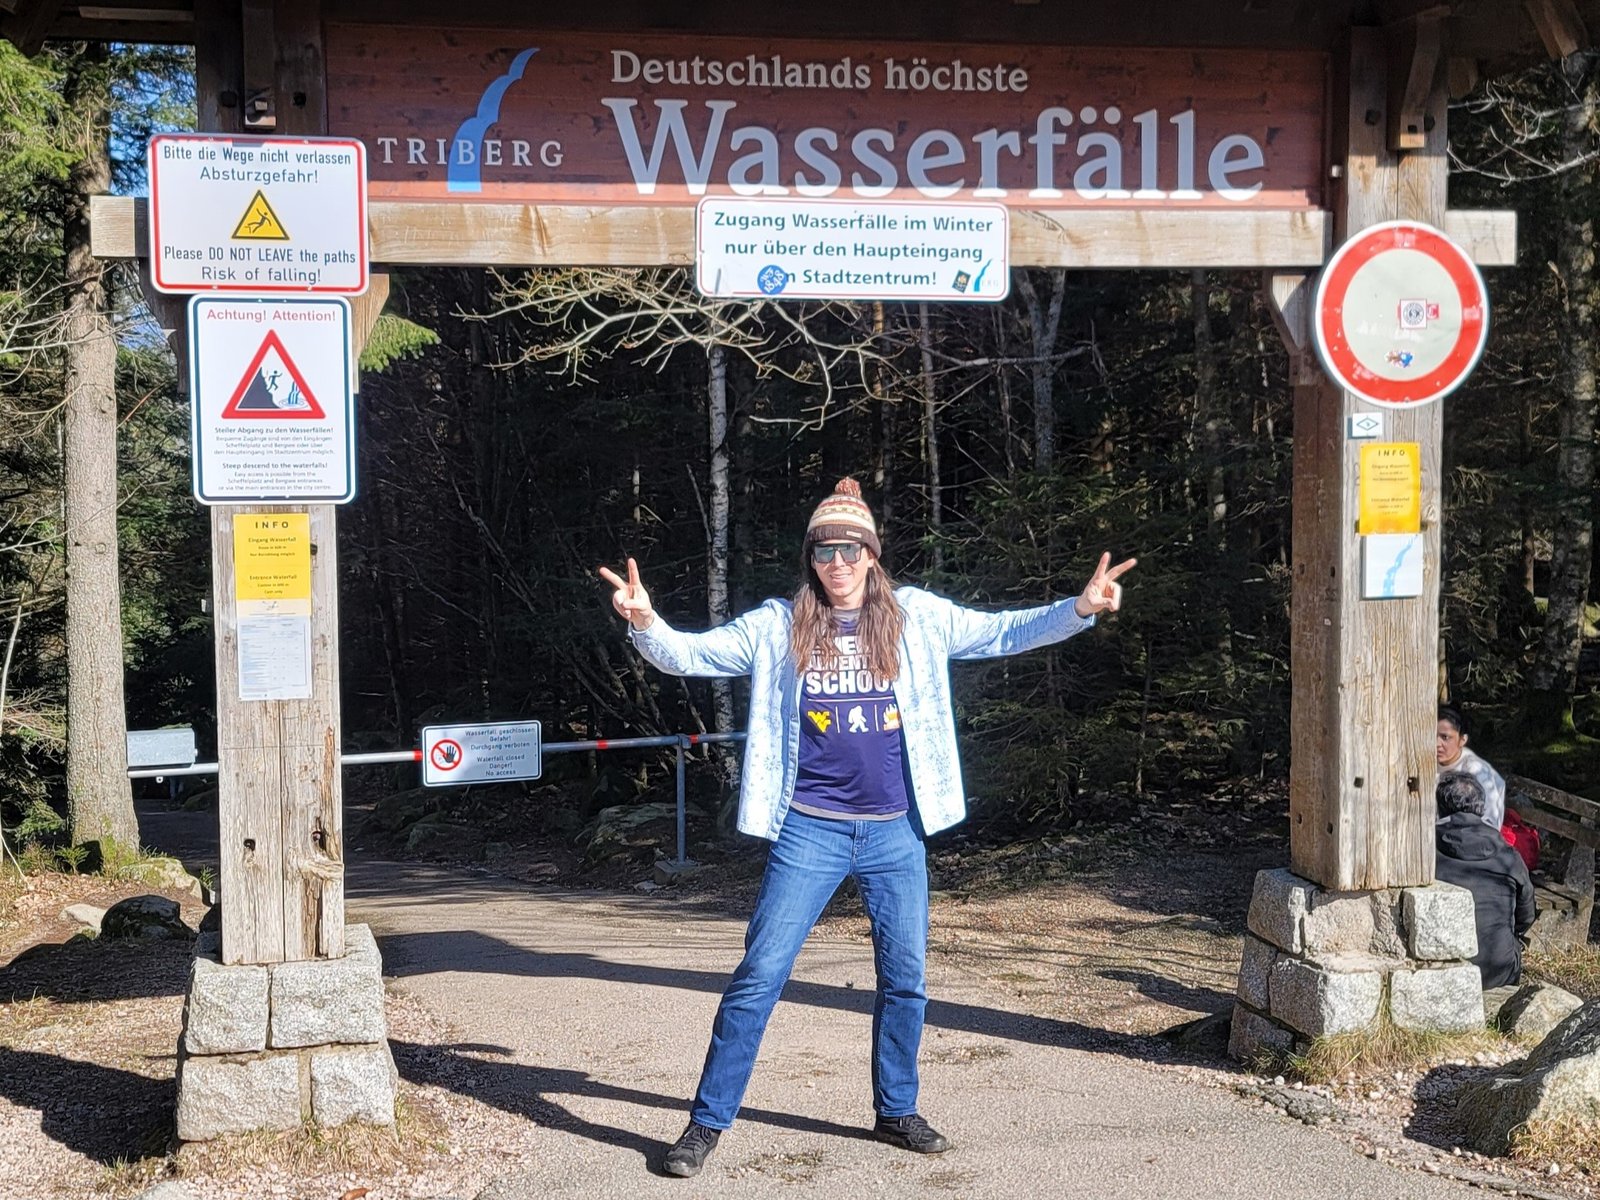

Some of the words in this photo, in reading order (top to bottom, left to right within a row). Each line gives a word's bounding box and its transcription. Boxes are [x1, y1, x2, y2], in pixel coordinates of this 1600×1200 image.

[611, 50, 871, 89] Deutschlands
[884, 57, 1029, 92] höchste
[164, 146, 192, 160] Bitte
[199, 147, 216, 160] die
[223, 148, 254, 165] Wege
[260, 149, 289, 163] nicht
[296, 150, 351, 165] verlassen
[377, 137, 564, 167] TRIBERG
[601, 97, 1265, 200] Wasserfälle
[200, 167, 318, 185] Absturzgefahr!
[714, 212, 786, 231] Zugang
[792, 212, 898, 230] Wasserfälle
[904, 215, 927, 231] im
[933, 216, 993, 232] Winter
[164, 246, 203, 260] Please
[209, 247, 224, 260] DO
[230, 248, 251, 261] NOT
[259, 248, 293, 262] LEAVE
[300, 249, 318, 263] the
[324, 250, 356, 266] paths
[725, 241, 757, 255] nur
[764, 240, 806, 256] über
[813, 241, 847, 257] den
[853, 242, 983, 263] Haupteingang
[202, 266, 236, 280] Risk
[245, 267, 260, 281] of
[268, 267, 321, 285] falling!
[803, 269, 937, 286] Stadtzentrum!
[207, 309, 267, 323] Achtung!
[273, 310, 336, 322] Attention!
[237, 427, 264, 435] Abgang
[255, 521, 289, 529] INFO
[805, 670, 893, 694] SCHOO
